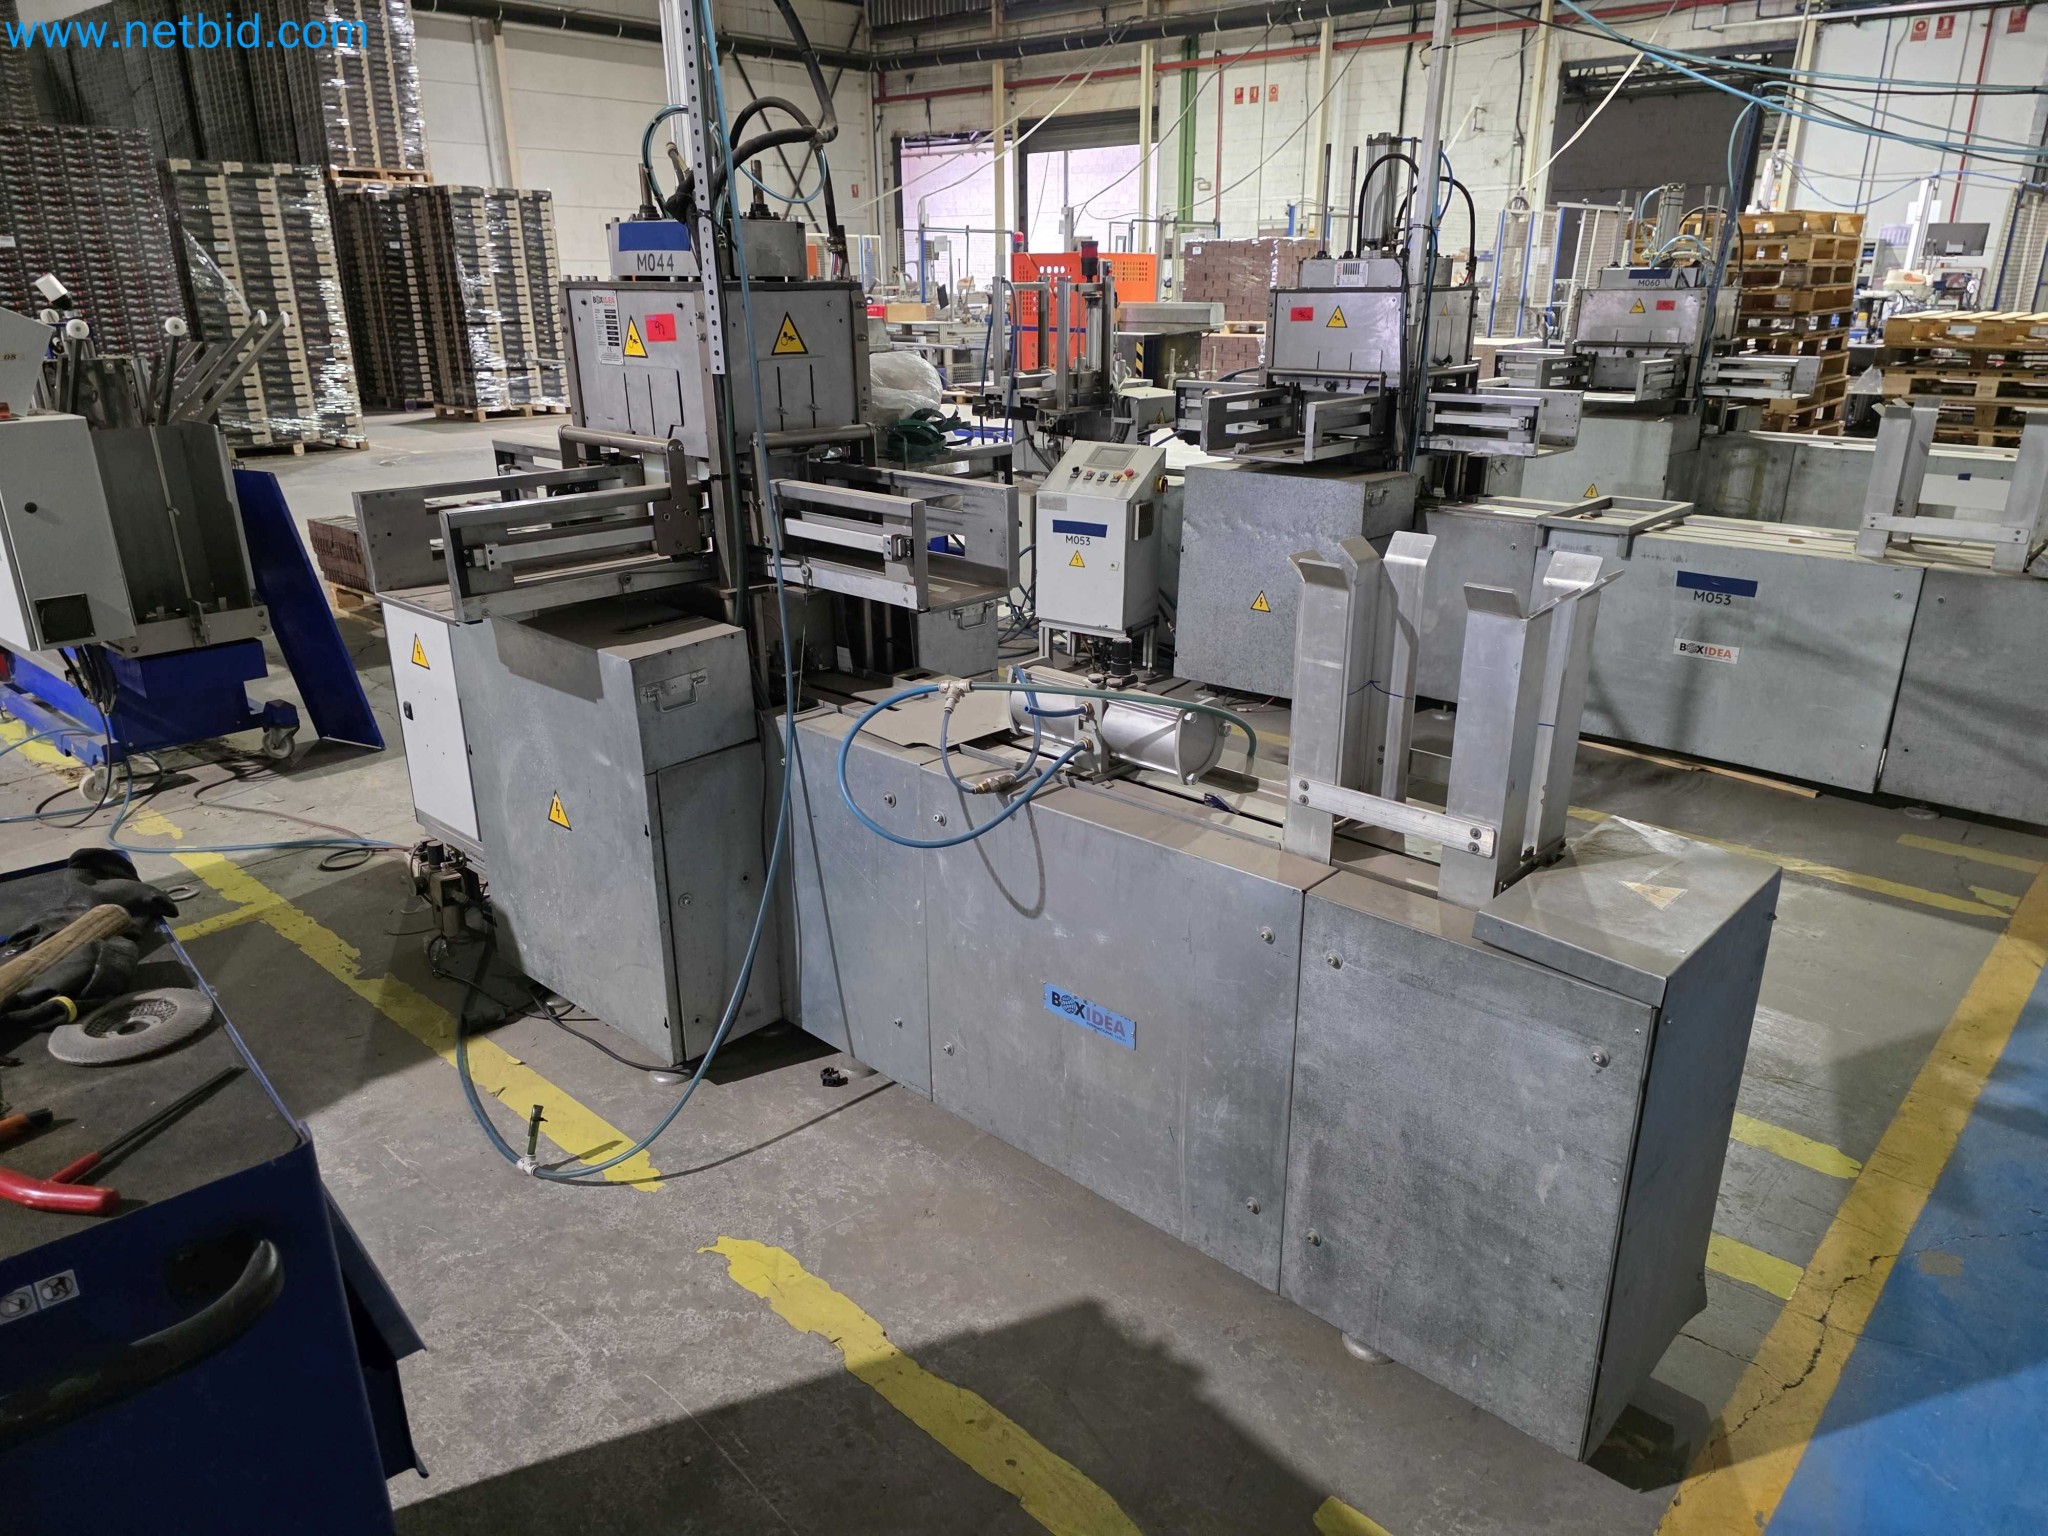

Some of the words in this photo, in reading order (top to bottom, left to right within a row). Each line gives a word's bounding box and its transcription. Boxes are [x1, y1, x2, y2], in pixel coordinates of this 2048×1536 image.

[636, 253, 674, 271] M044
[1065, 535, 1091, 546] M053
[1694, 590, 1732, 606] M053
[1679, 643, 1732, 659] BOXIDEA
[1051, 990, 1126, 1037] BOXIDEA
